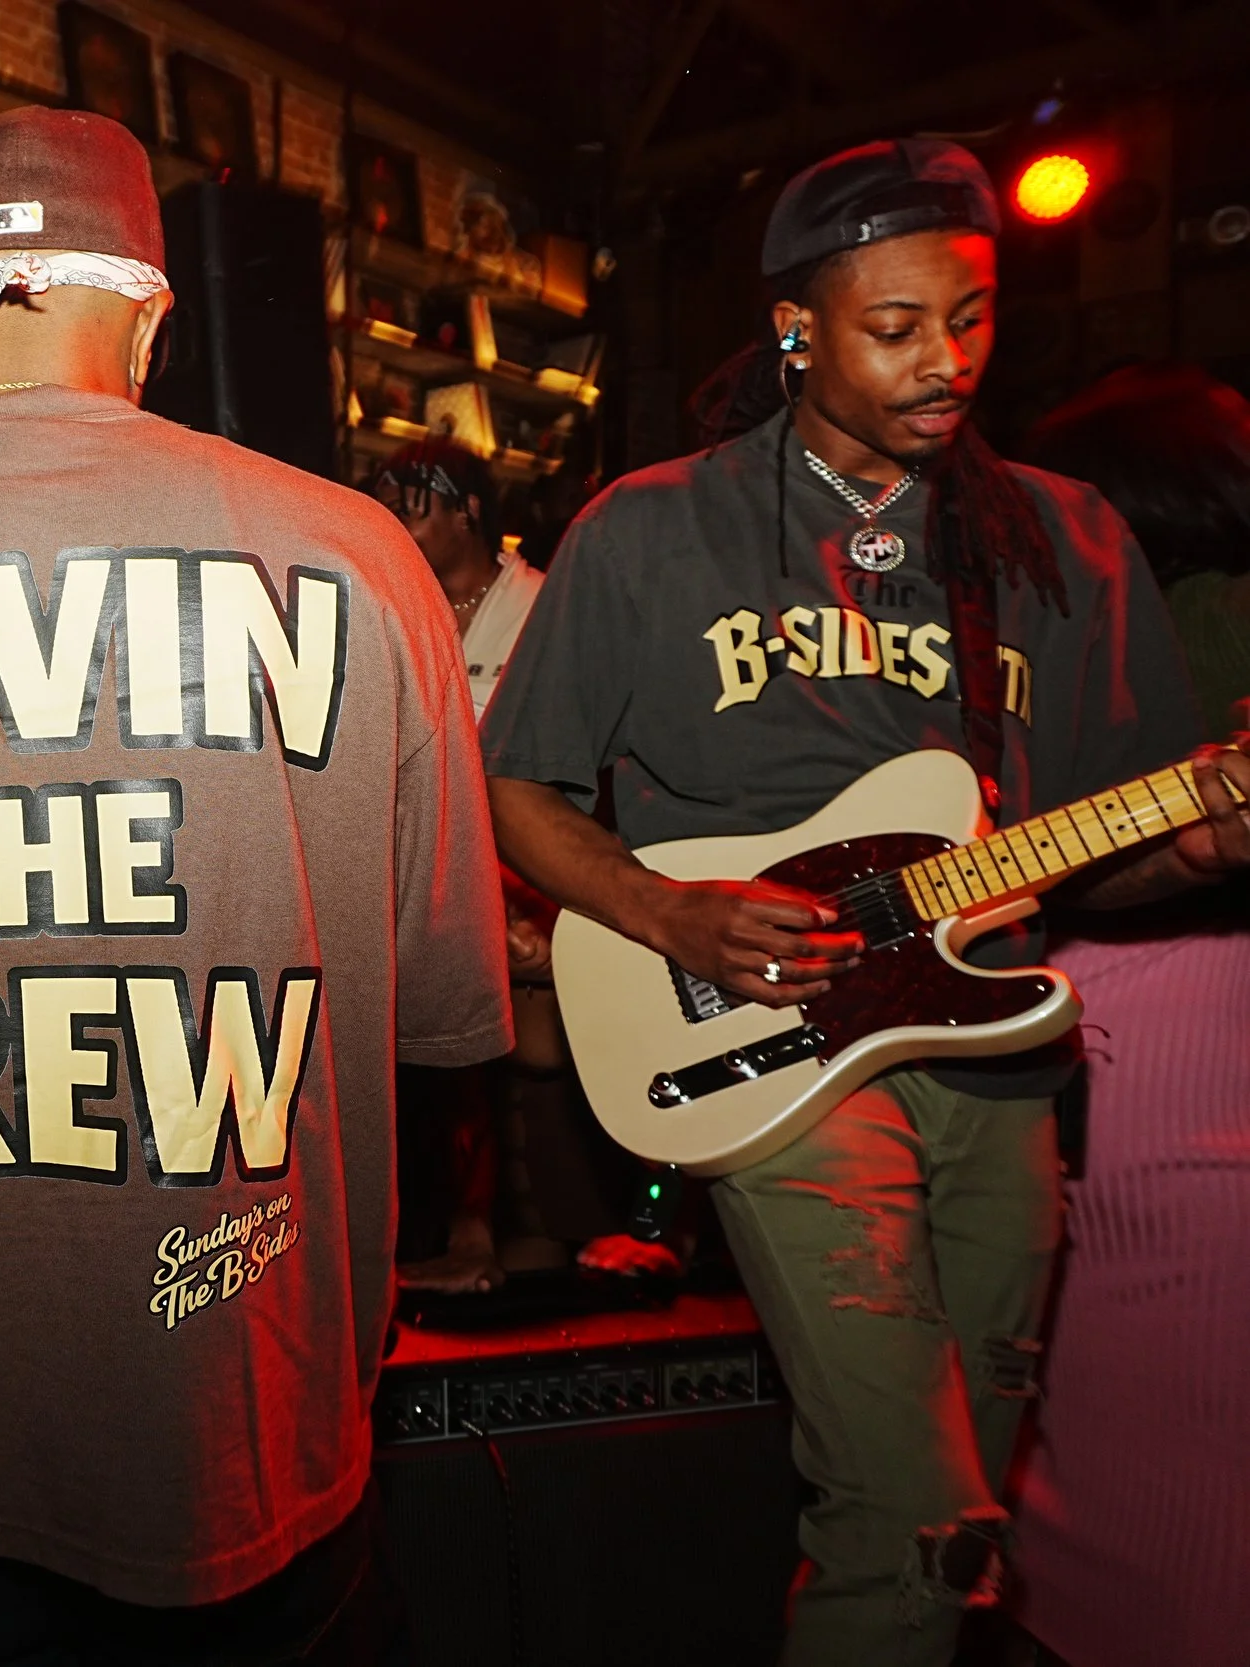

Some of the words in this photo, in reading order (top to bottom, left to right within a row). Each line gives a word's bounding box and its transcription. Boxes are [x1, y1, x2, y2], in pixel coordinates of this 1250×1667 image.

[702, 604, 953, 714] B-SIDES
[149, 1269, 215, 1330] The
[205, 1220, 300, 1300] B-Sides
[152, 1203, 265, 1286] Sunday's
[266, 1193, 292, 1220] on
